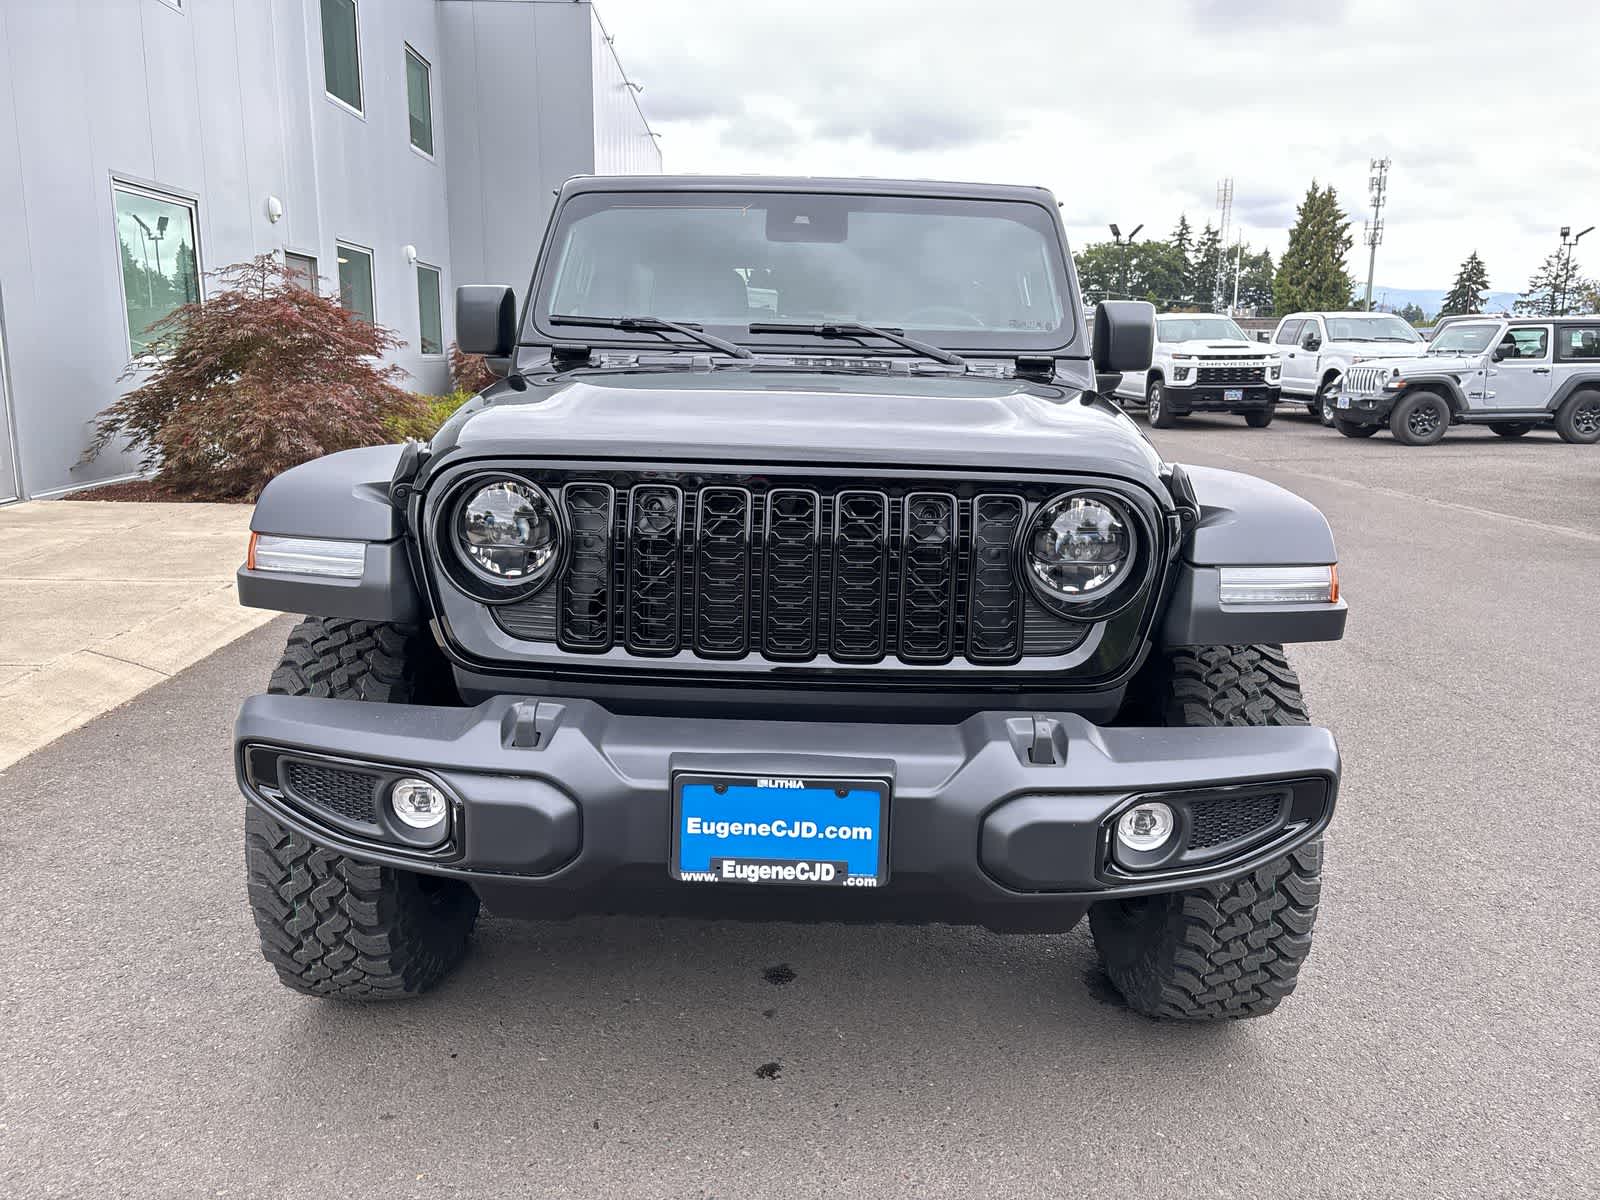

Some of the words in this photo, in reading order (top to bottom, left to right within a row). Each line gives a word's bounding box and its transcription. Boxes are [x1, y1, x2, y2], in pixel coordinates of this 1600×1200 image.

[768, 779, 805, 789] LITHIA
[687, 817, 872, 840] EugeneCJD.com
[680, 872, 719, 882] www.
[722, 860, 835, 883] EugeneCJD
[842, 877, 877, 887] .com
